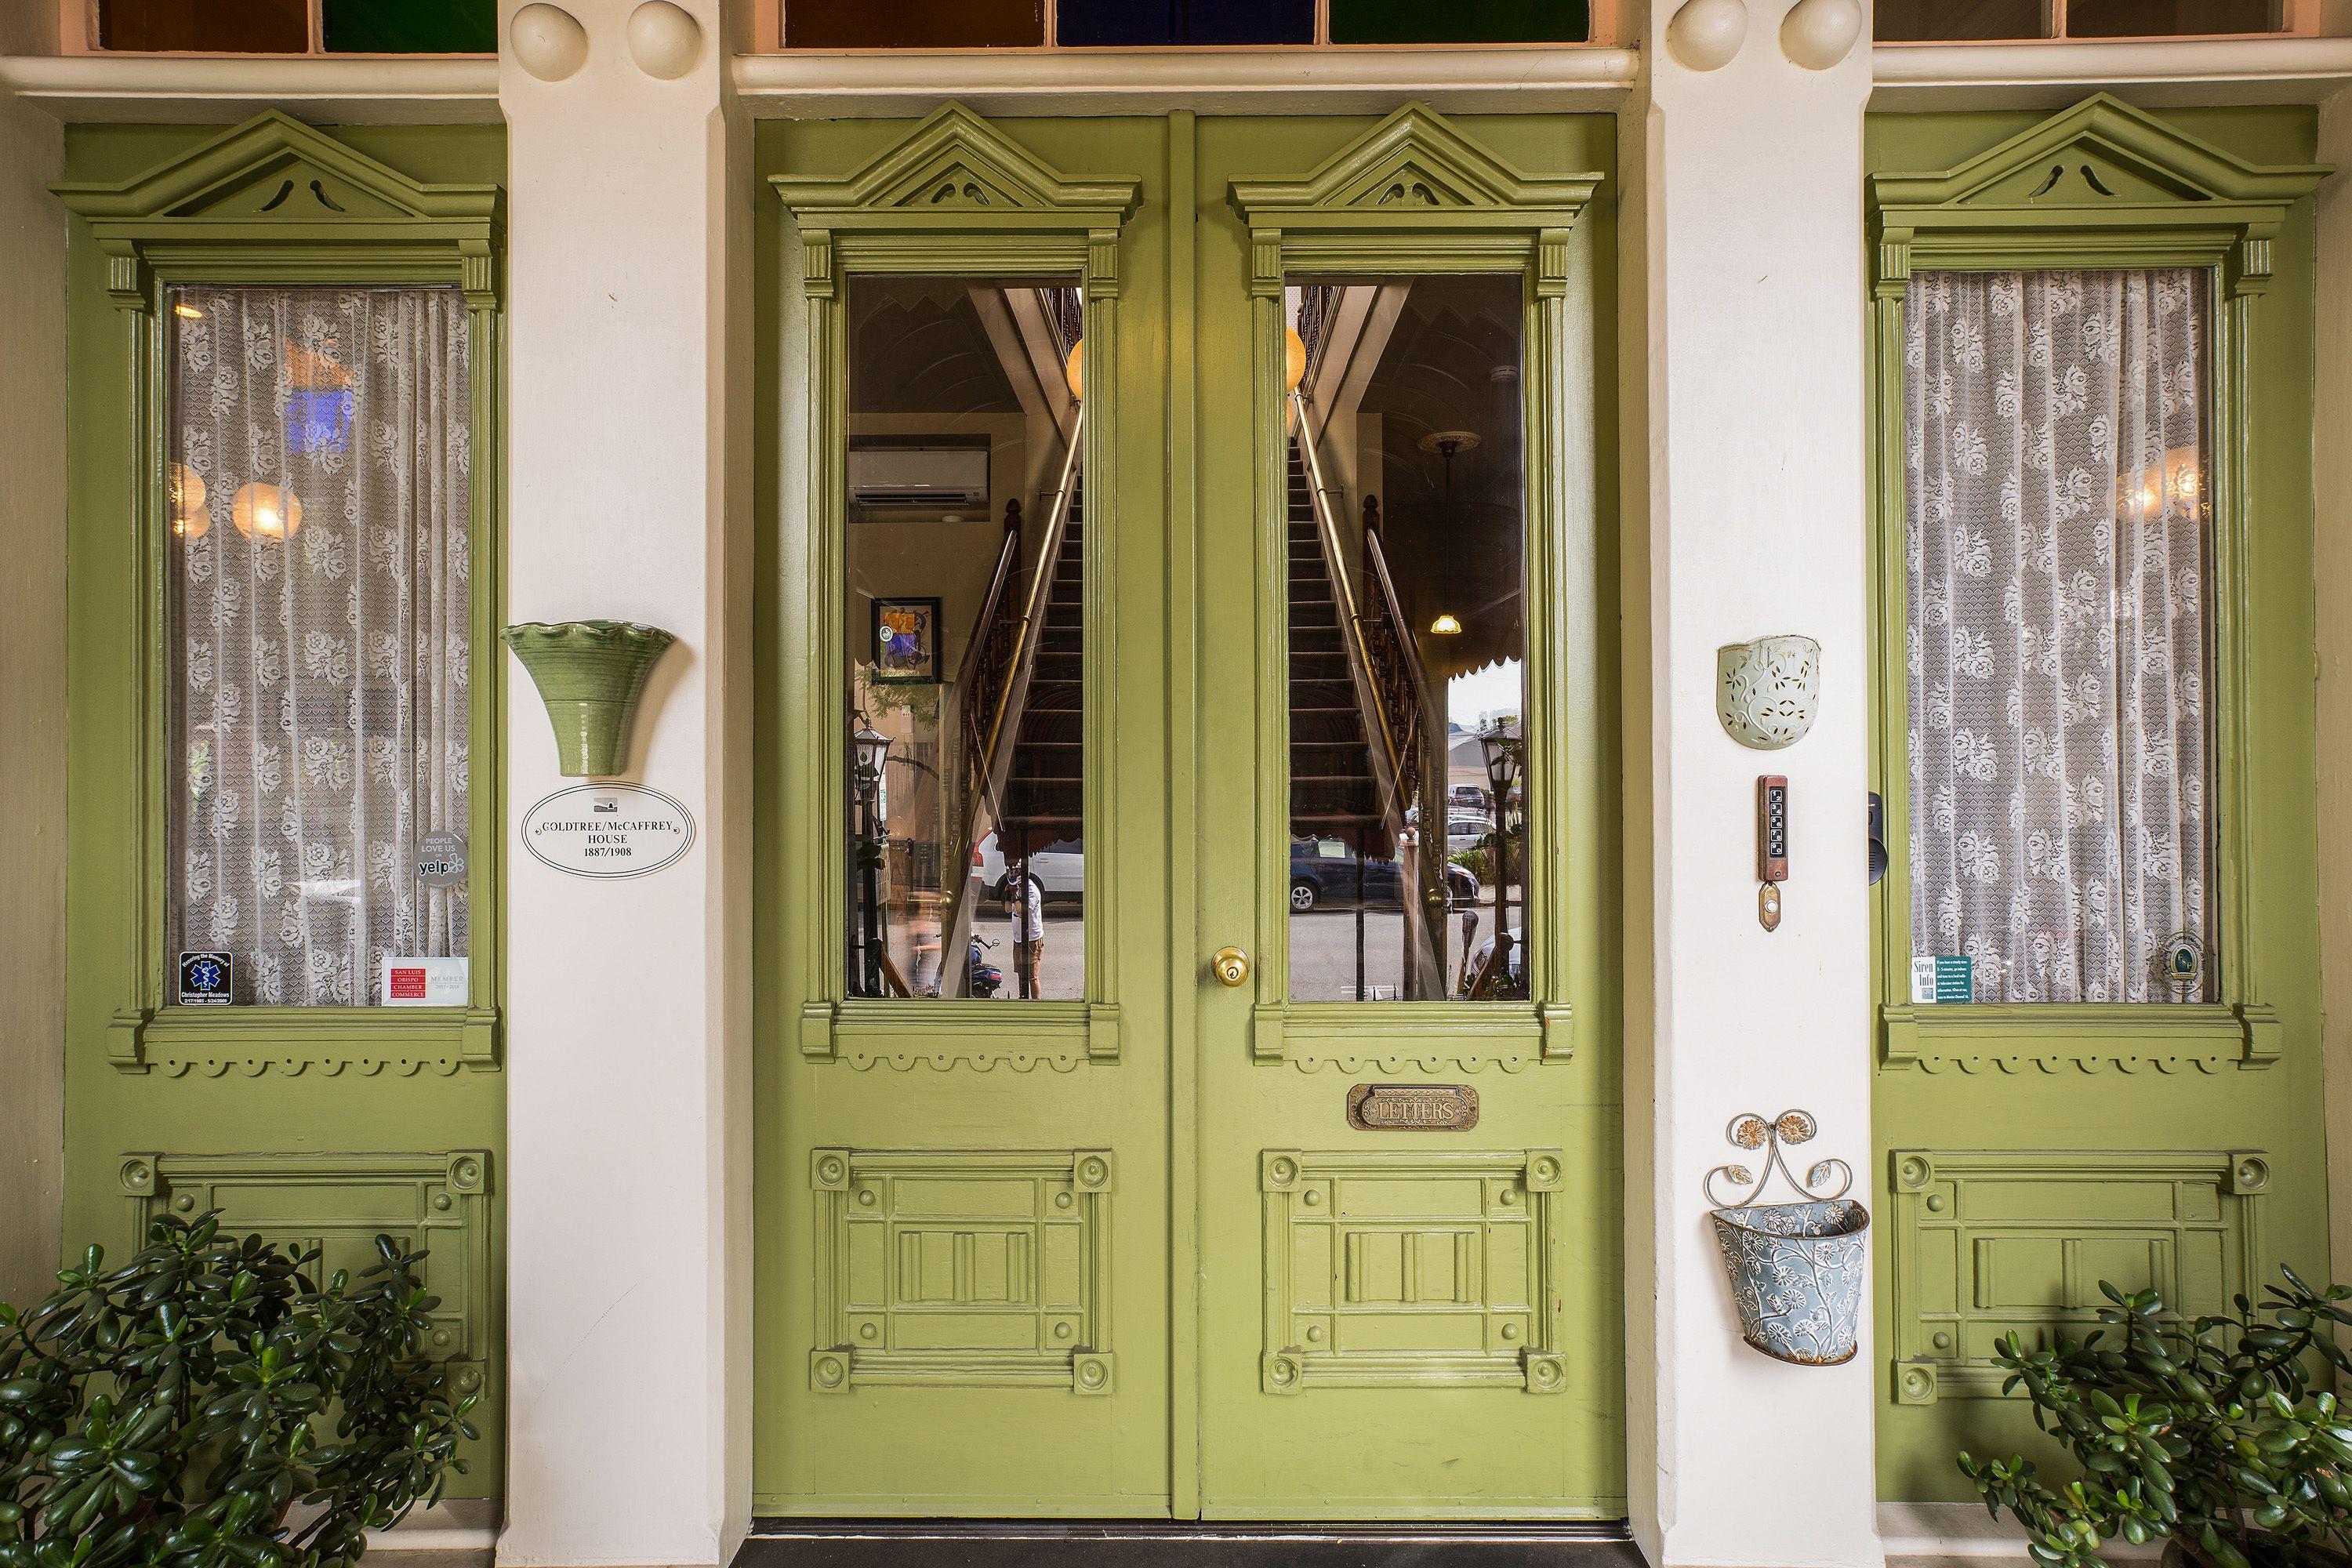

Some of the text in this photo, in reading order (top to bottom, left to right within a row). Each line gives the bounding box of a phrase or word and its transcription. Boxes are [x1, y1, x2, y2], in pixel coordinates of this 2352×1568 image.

[542, 821, 673, 832] GOLDTREE/McCAFFREY
[588, 834, 628, 844] HOUSE
[584, 848, 632, 857] 1887/1908
[419, 859, 449, 876] yelp
[1914, 960, 1933, 972] Siren
[1919, 974, 1934, 985] Info
[1377, 1102, 1454, 1120] LETTERS
